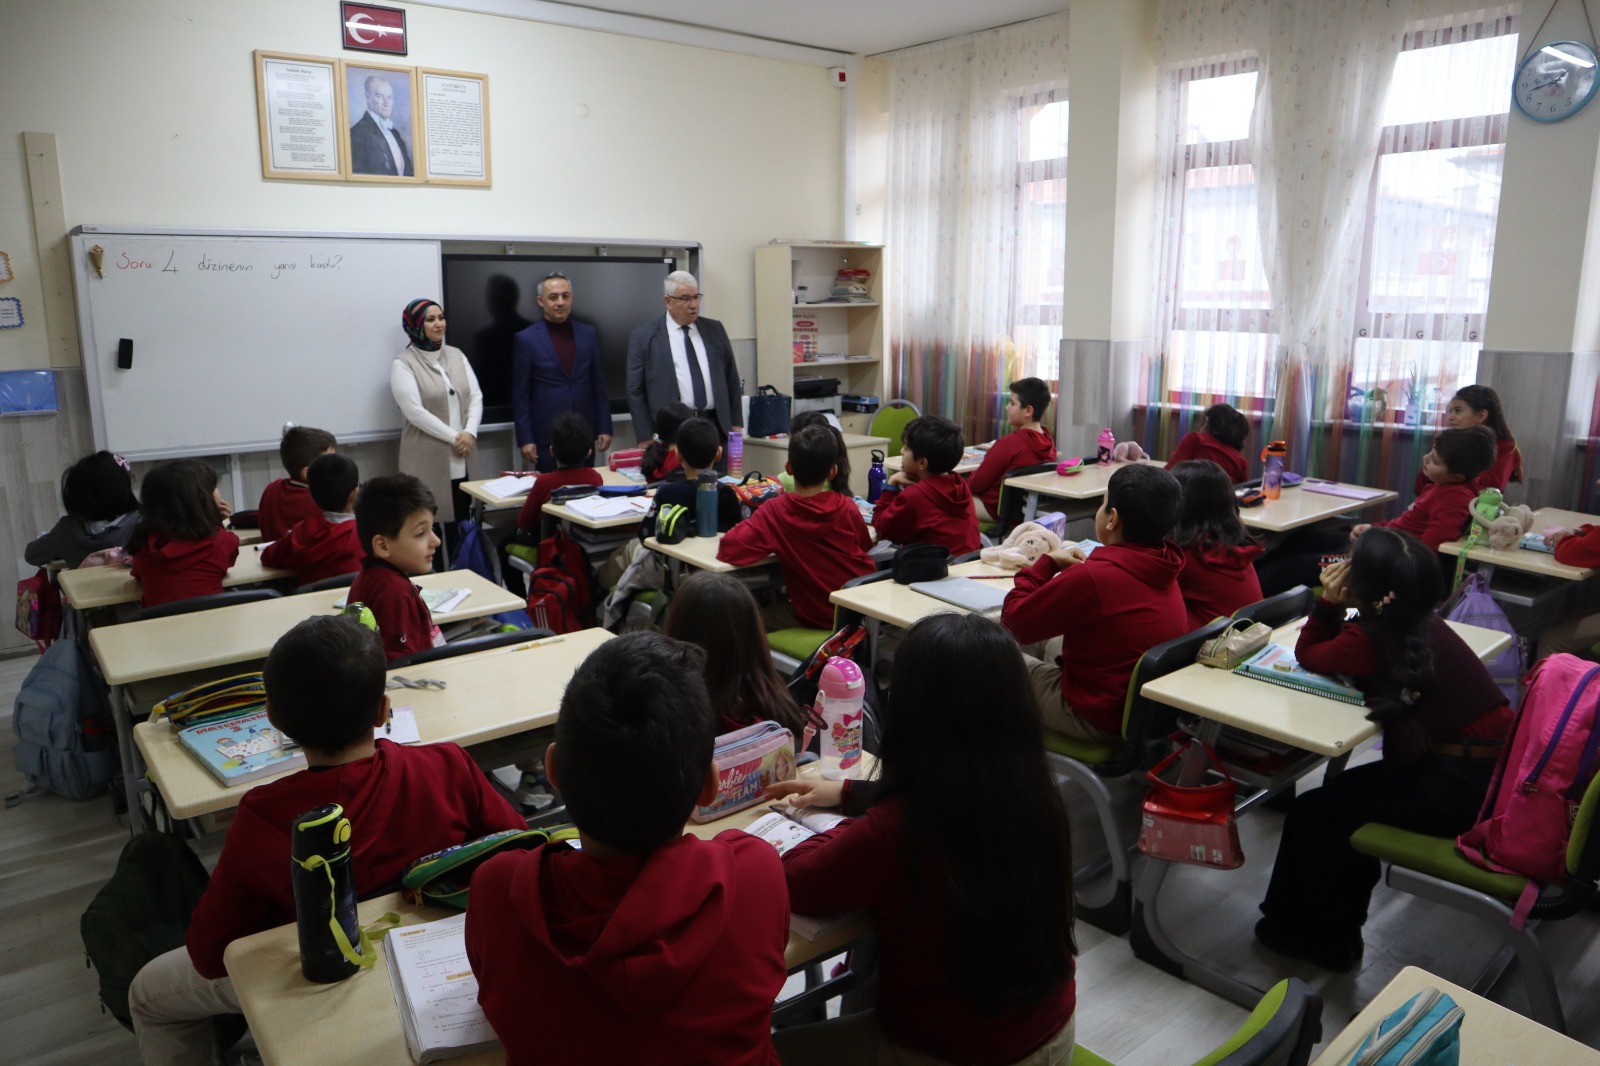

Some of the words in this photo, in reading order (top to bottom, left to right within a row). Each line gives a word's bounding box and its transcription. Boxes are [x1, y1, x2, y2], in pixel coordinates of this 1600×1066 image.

[1522, 81, 1528, 90] 9
[1526, 93, 1532, 102] 8
[1565, 97, 1572, 107] 5
[1536, 102, 1542, 111] 7
[1550, 103, 1556, 113] 6
[161, 249, 180, 275] 4
[197, 253, 253, 272] düzinenin
[1359, 328, 1367, 337] G
[1416, 330, 1424, 339] G
[1469, 331, 1477, 340] G
[731, 780, 759, 803] TEAM
